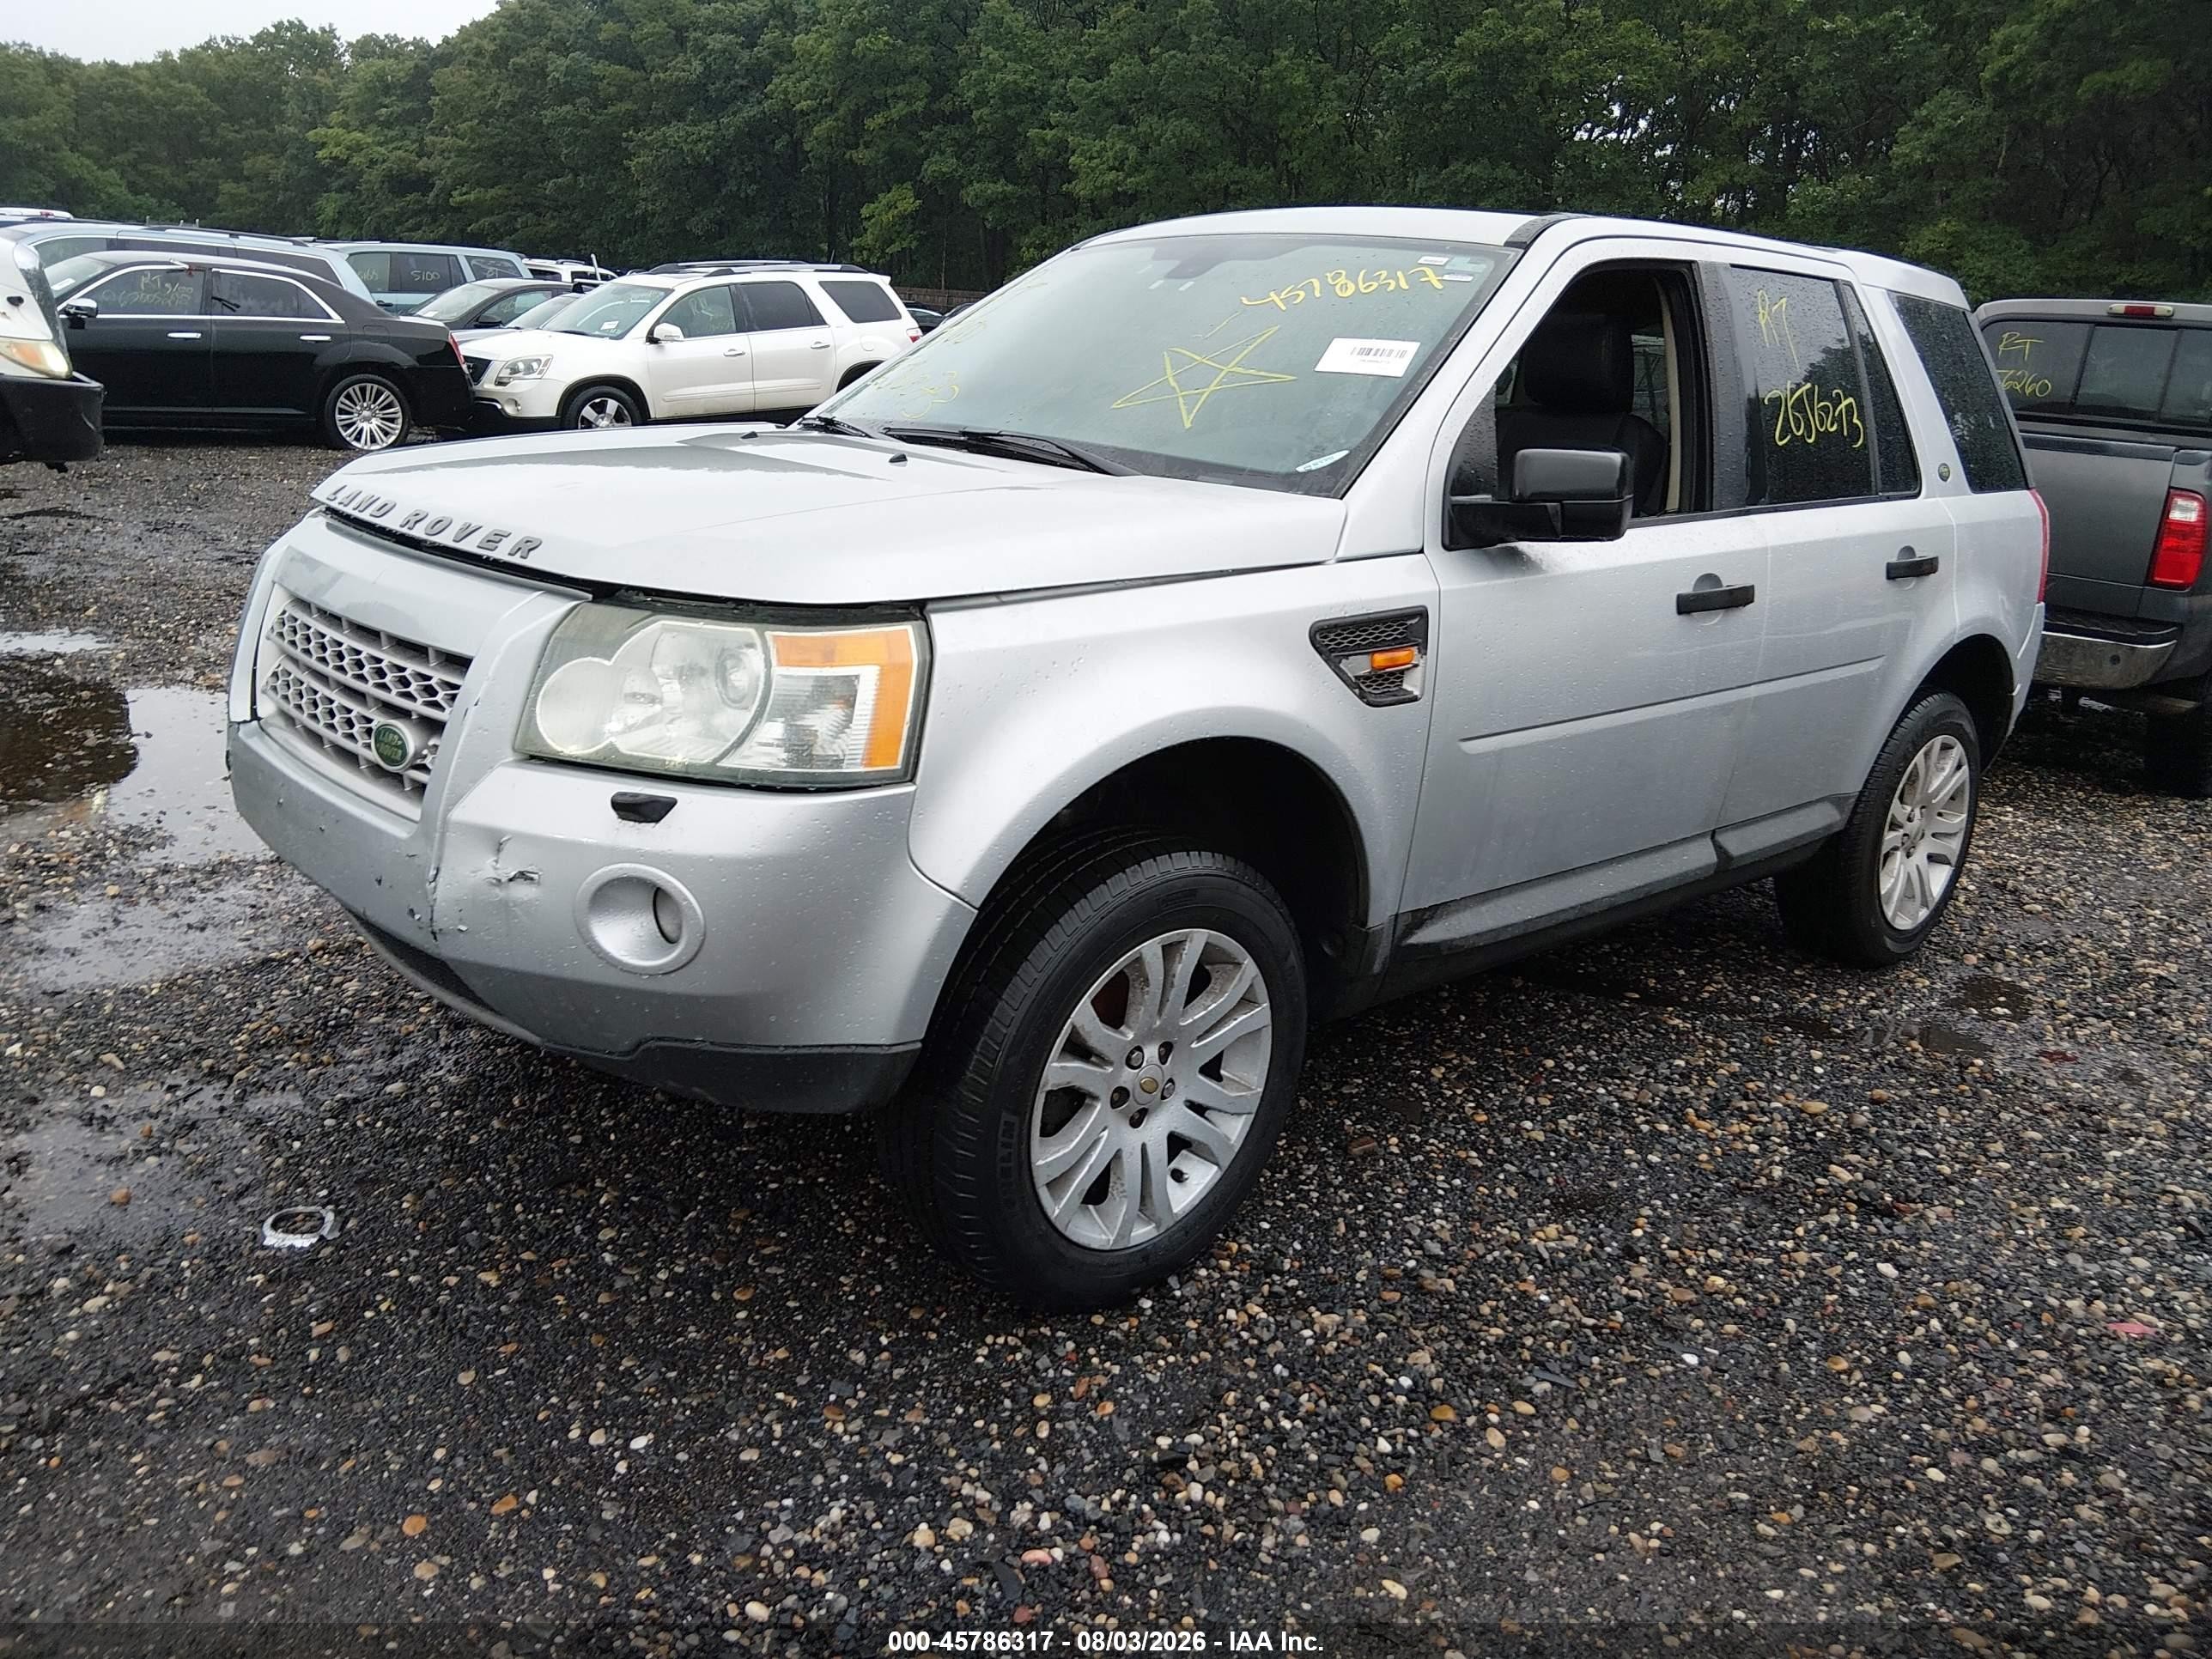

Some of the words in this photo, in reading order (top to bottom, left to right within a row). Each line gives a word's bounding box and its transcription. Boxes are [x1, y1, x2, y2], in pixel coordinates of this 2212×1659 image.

[1240, 266, 1443, 312] 45786317
[1997, 331, 2045, 361] RT
[326, 484, 397, 518] LAND
[398, 508, 543, 559] ROVER
